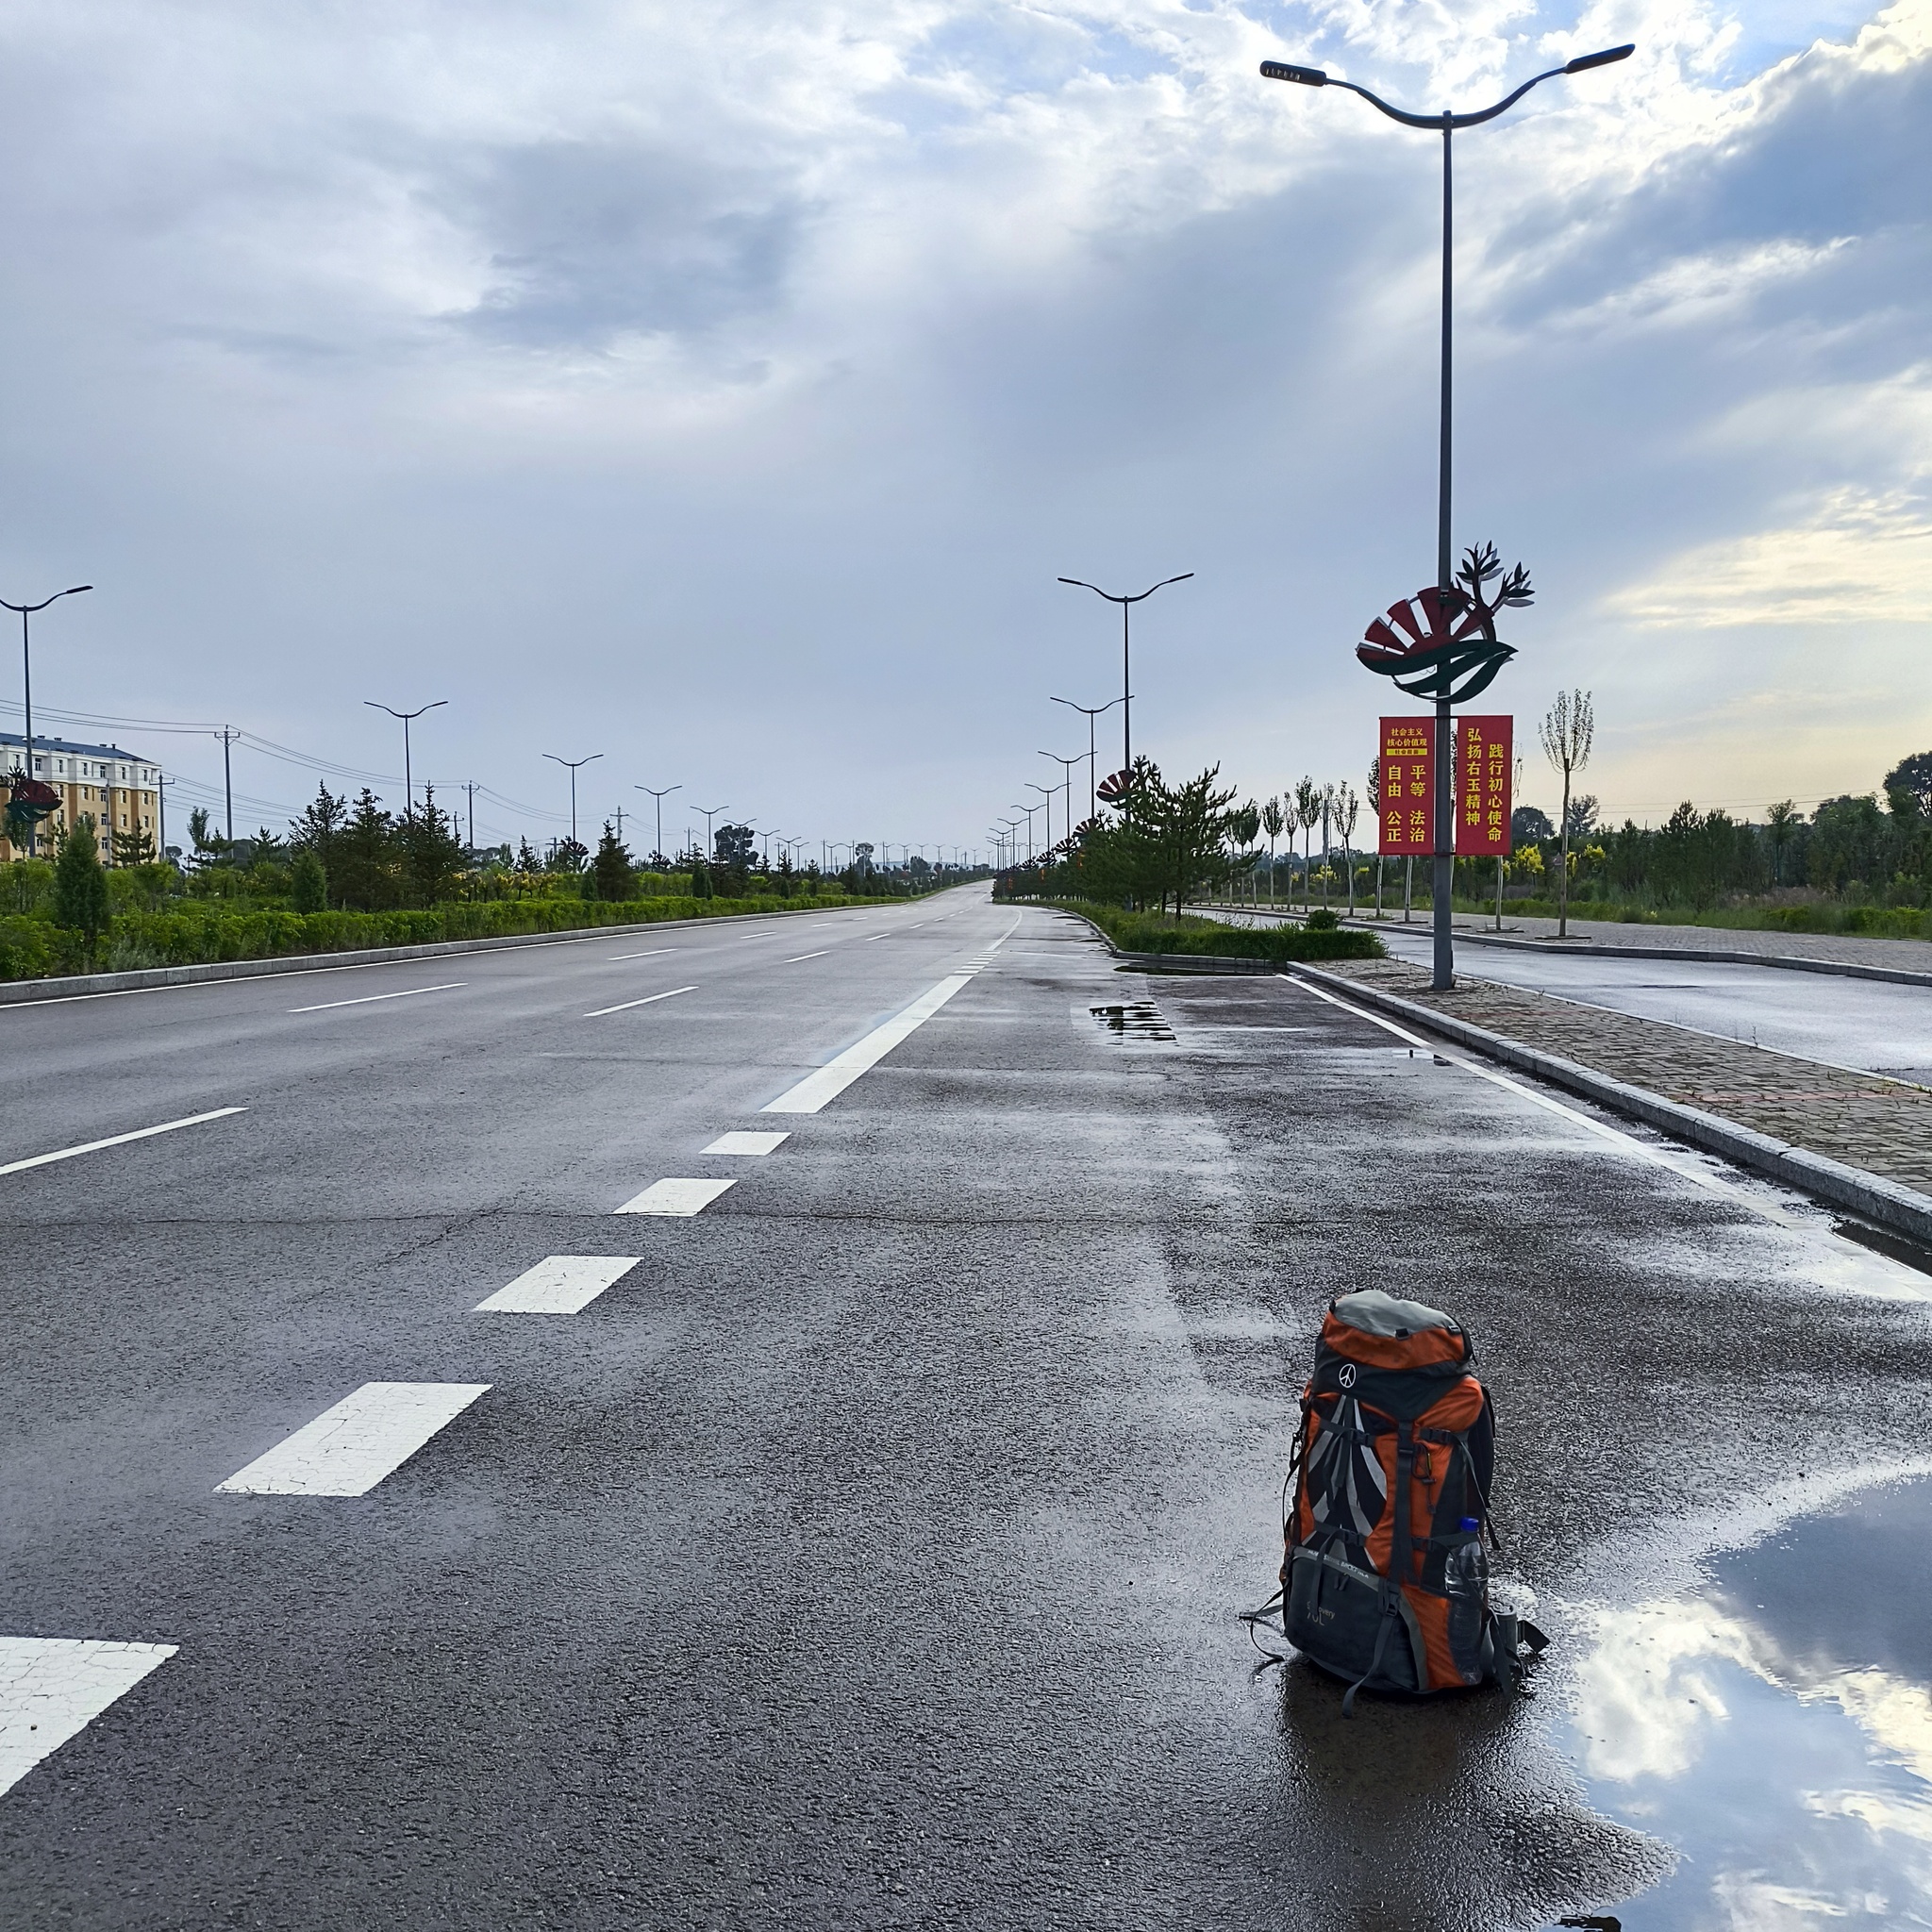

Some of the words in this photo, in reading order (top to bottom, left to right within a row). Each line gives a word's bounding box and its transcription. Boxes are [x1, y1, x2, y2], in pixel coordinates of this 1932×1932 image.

[1387, 738, 1427, 746] 核心价值观
[1391, 727, 1424, 737] 社会主义
[1388, 764, 1402, 798] 自由
[1409, 764, 1426, 797] 平等
[1465, 727, 1482, 826] 弘扬右玉精神
[1487, 743, 1504, 842] 践行初心使命
[1387, 809, 1402, 842] 公正
[1409, 809, 1425, 842] 法治
